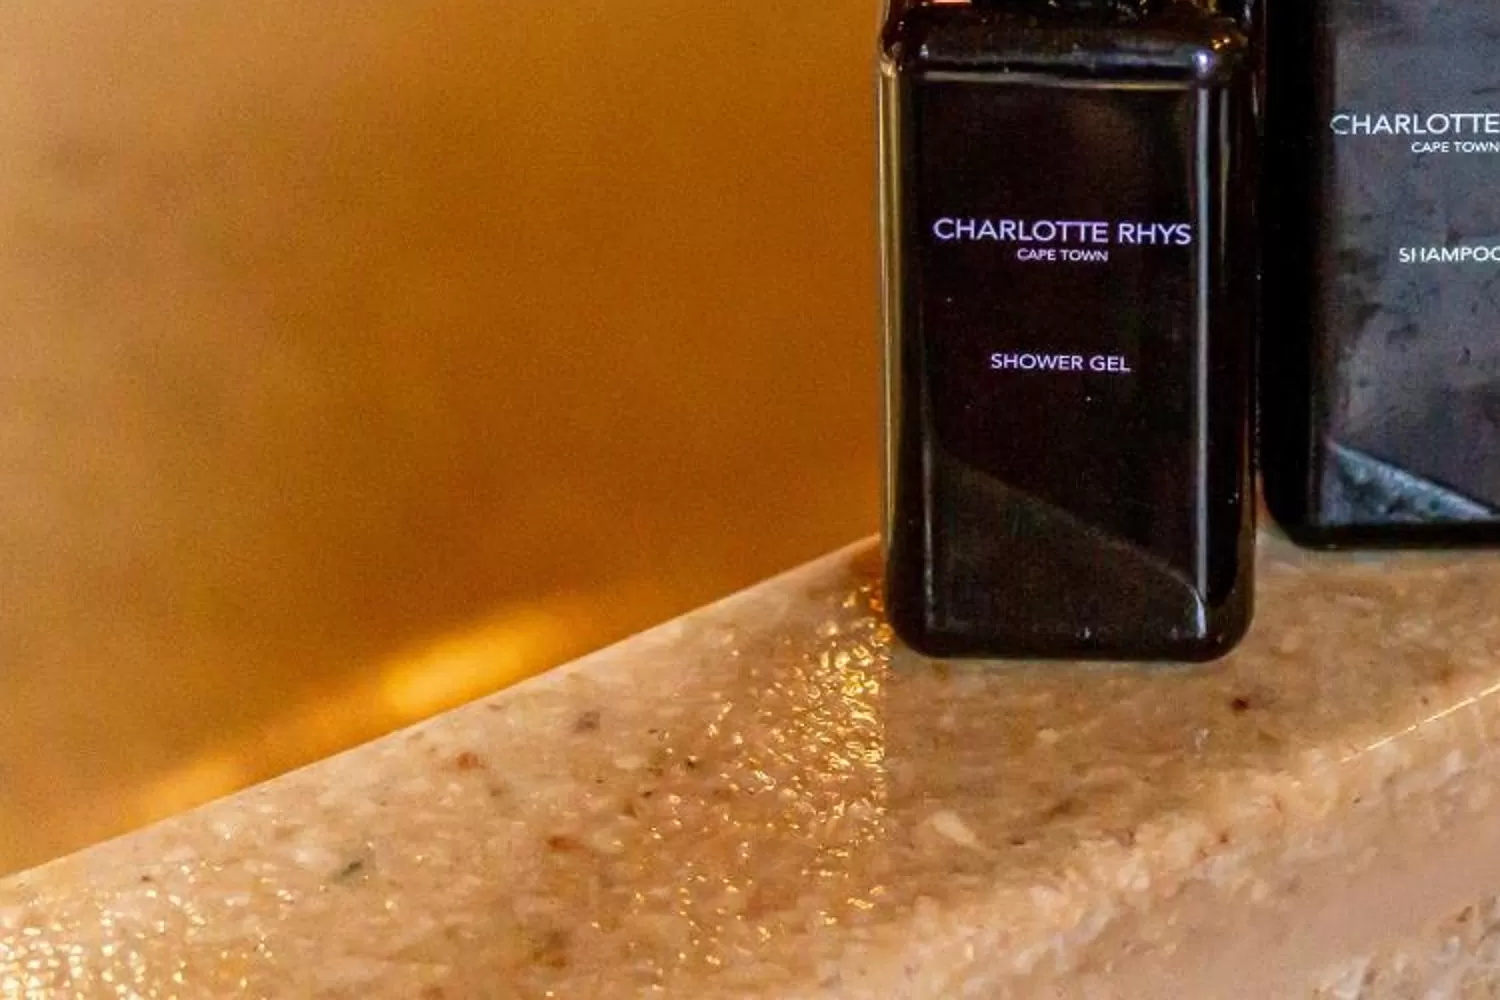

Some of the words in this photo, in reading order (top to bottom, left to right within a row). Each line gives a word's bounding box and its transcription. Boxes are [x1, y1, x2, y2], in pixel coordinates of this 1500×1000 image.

[1330, 113, 1500, 135] CHARLOTTE
[1411, 141, 1449, 153] CAPE
[1454, 141, 1500, 153] TOWN
[933, 218, 1109, 243] CHARLOTTE
[1118, 223, 1192, 245] RHYS
[1017, 248, 1056, 261] CAPE
[1060, 249, 1108, 262] TOWN
[991, 353, 1083, 370] SHOWER
[1089, 356, 1130, 372] GEL
